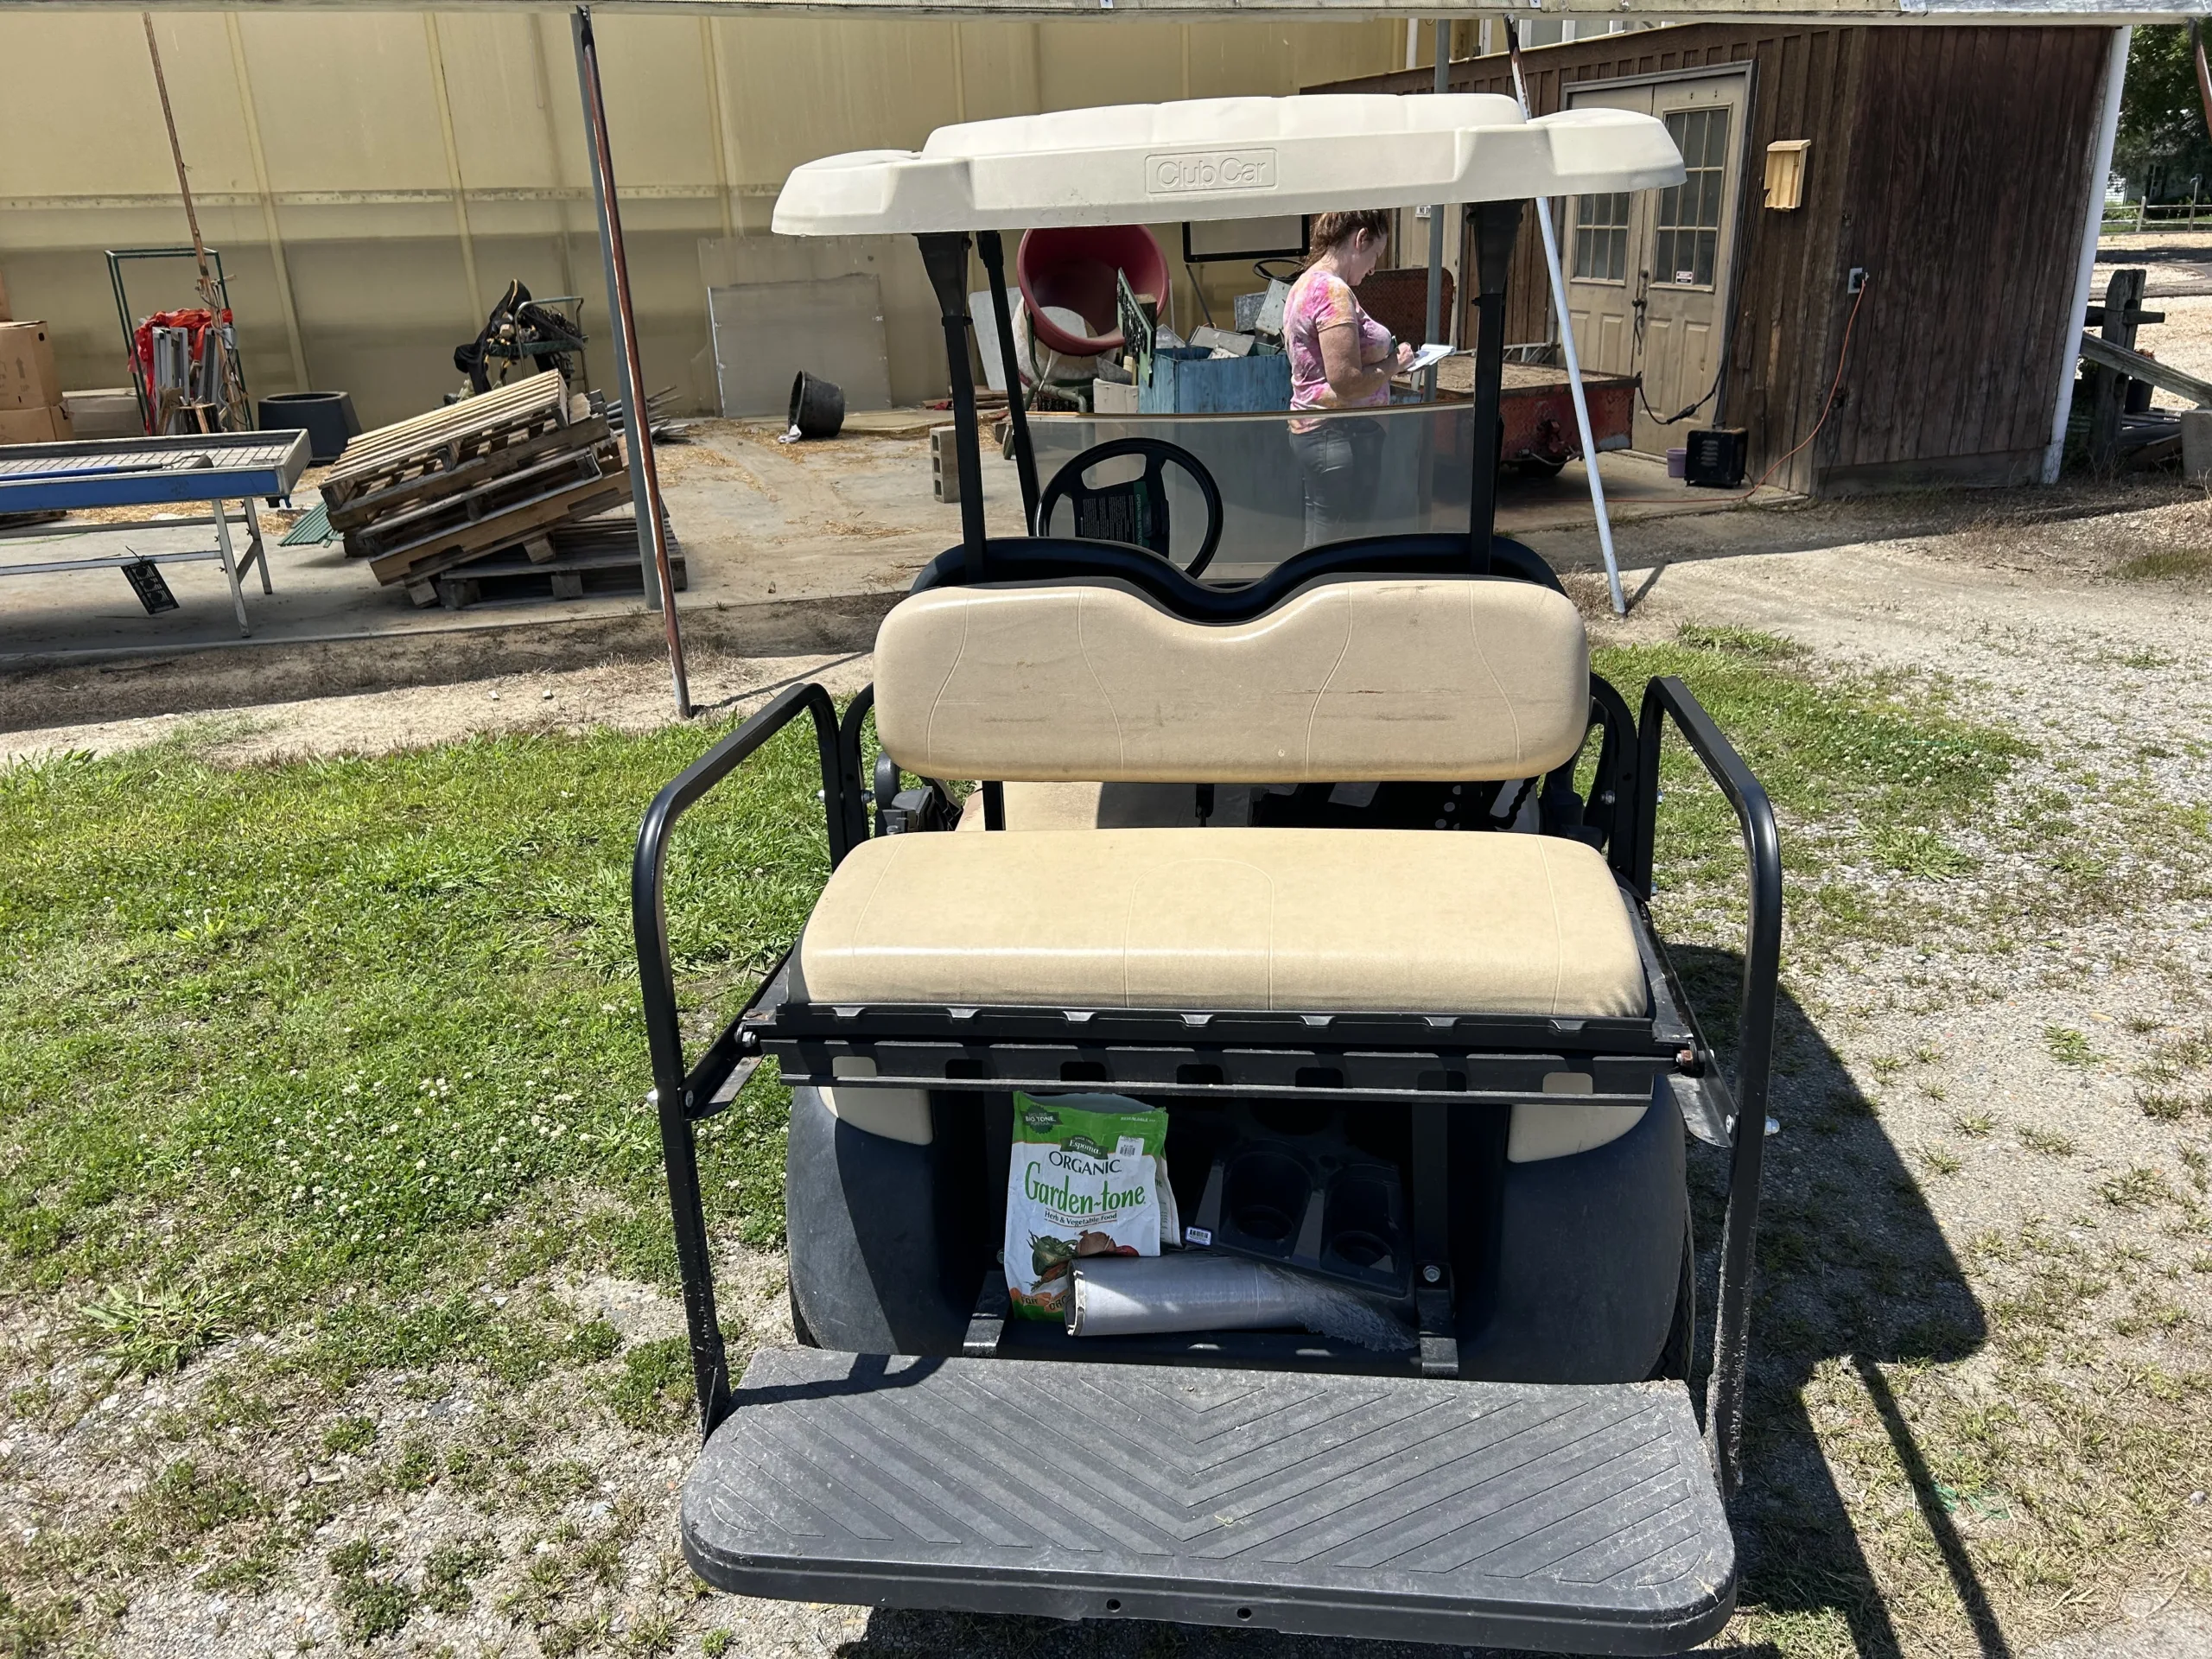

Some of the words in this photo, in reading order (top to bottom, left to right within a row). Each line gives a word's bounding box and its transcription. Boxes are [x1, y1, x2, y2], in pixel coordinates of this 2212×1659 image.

[1156, 160, 1217, 188] Club
[1219, 158, 1267, 184] Car
[1069, 1140, 1098, 1155] Espoma
[1048, 1151, 1121, 1176] ORGANIC
[1044, 1210, 1059, 1222] Herb
[1066, 1217, 1099, 1228] Vegetable
[1021, 1296, 1038, 1305] FOR
